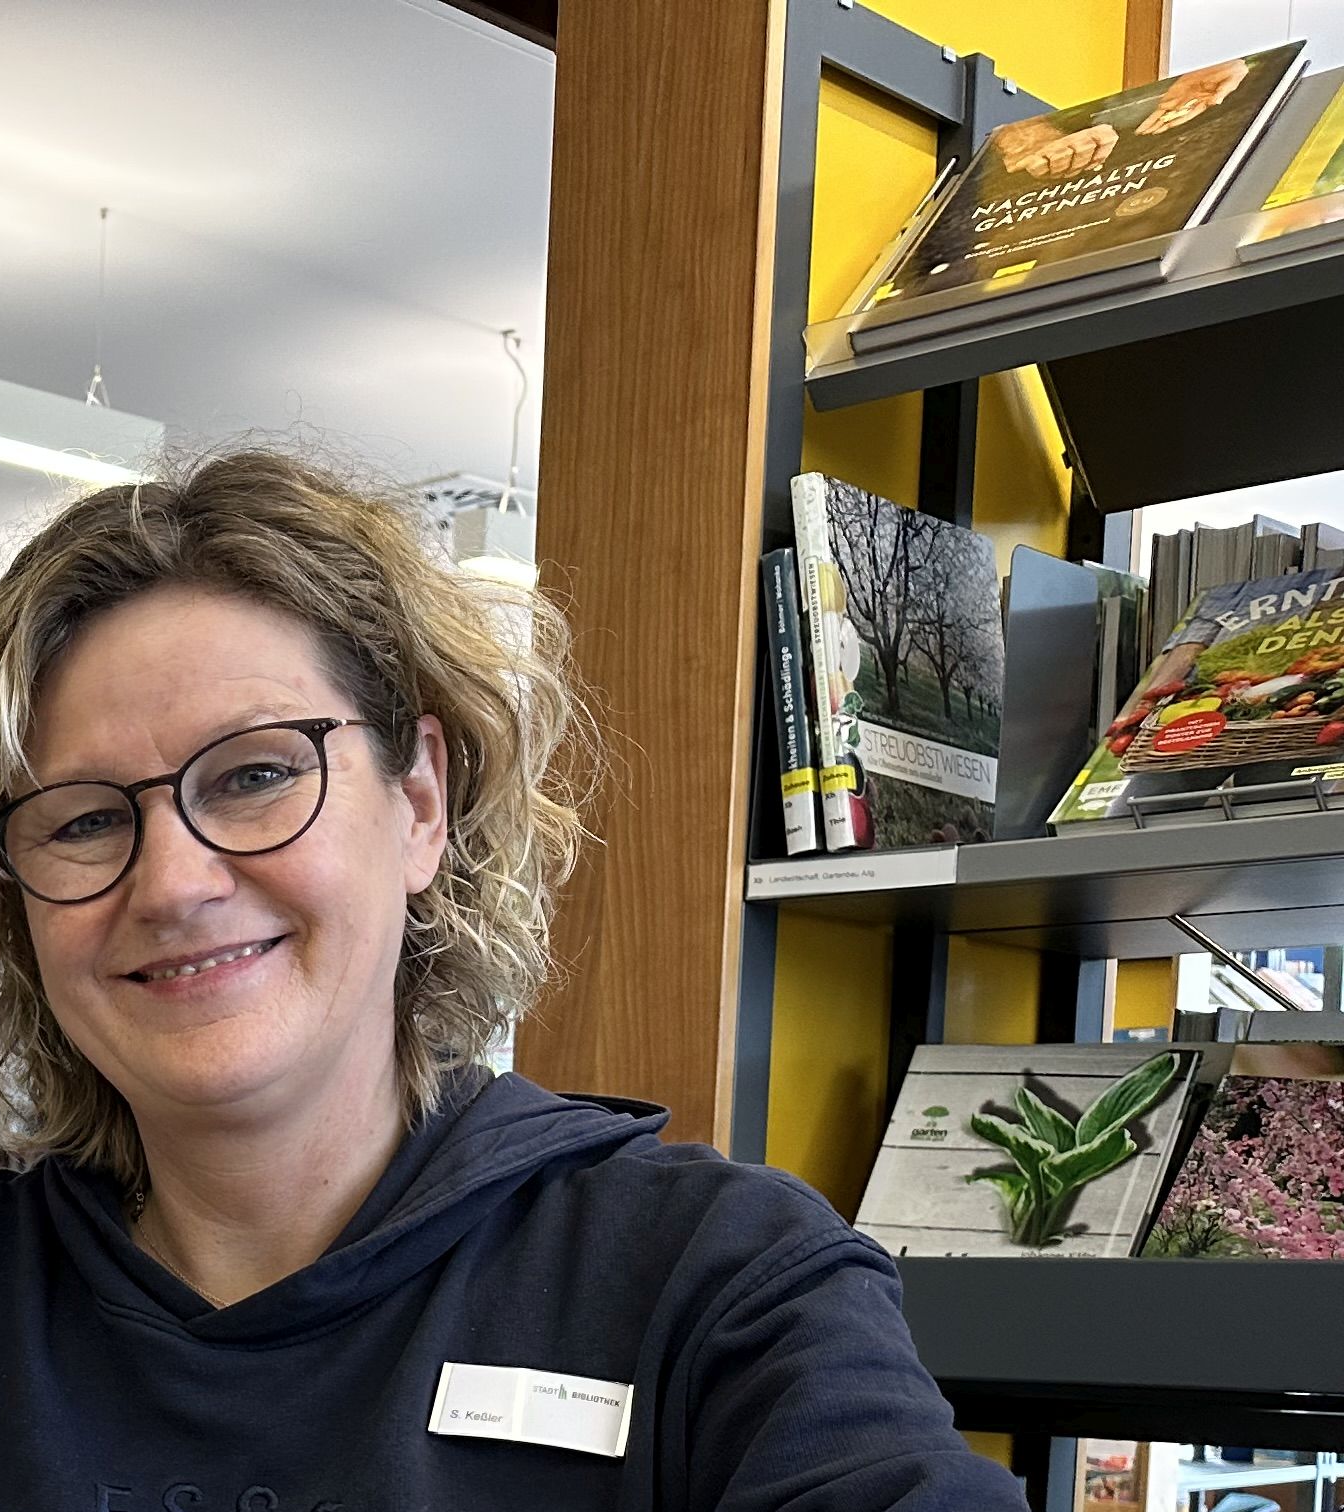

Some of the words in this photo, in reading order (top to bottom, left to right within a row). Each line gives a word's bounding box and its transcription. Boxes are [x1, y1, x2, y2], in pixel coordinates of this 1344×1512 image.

[972, 155, 1176, 219] NACHHALTIG
[974, 177, 1148, 232] GÄRTNERN
[1255, 626, 1344, 654] DEN
[780, 646, 795, 712] Schädlinge
[785, 726, 799, 770] kheiten
[864, 728, 991, 784] STREUOBSTWIESEN
[450, 1409, 462, 1420] S.
[571, 1391, 621, 1407] BIBLIOTHEK
